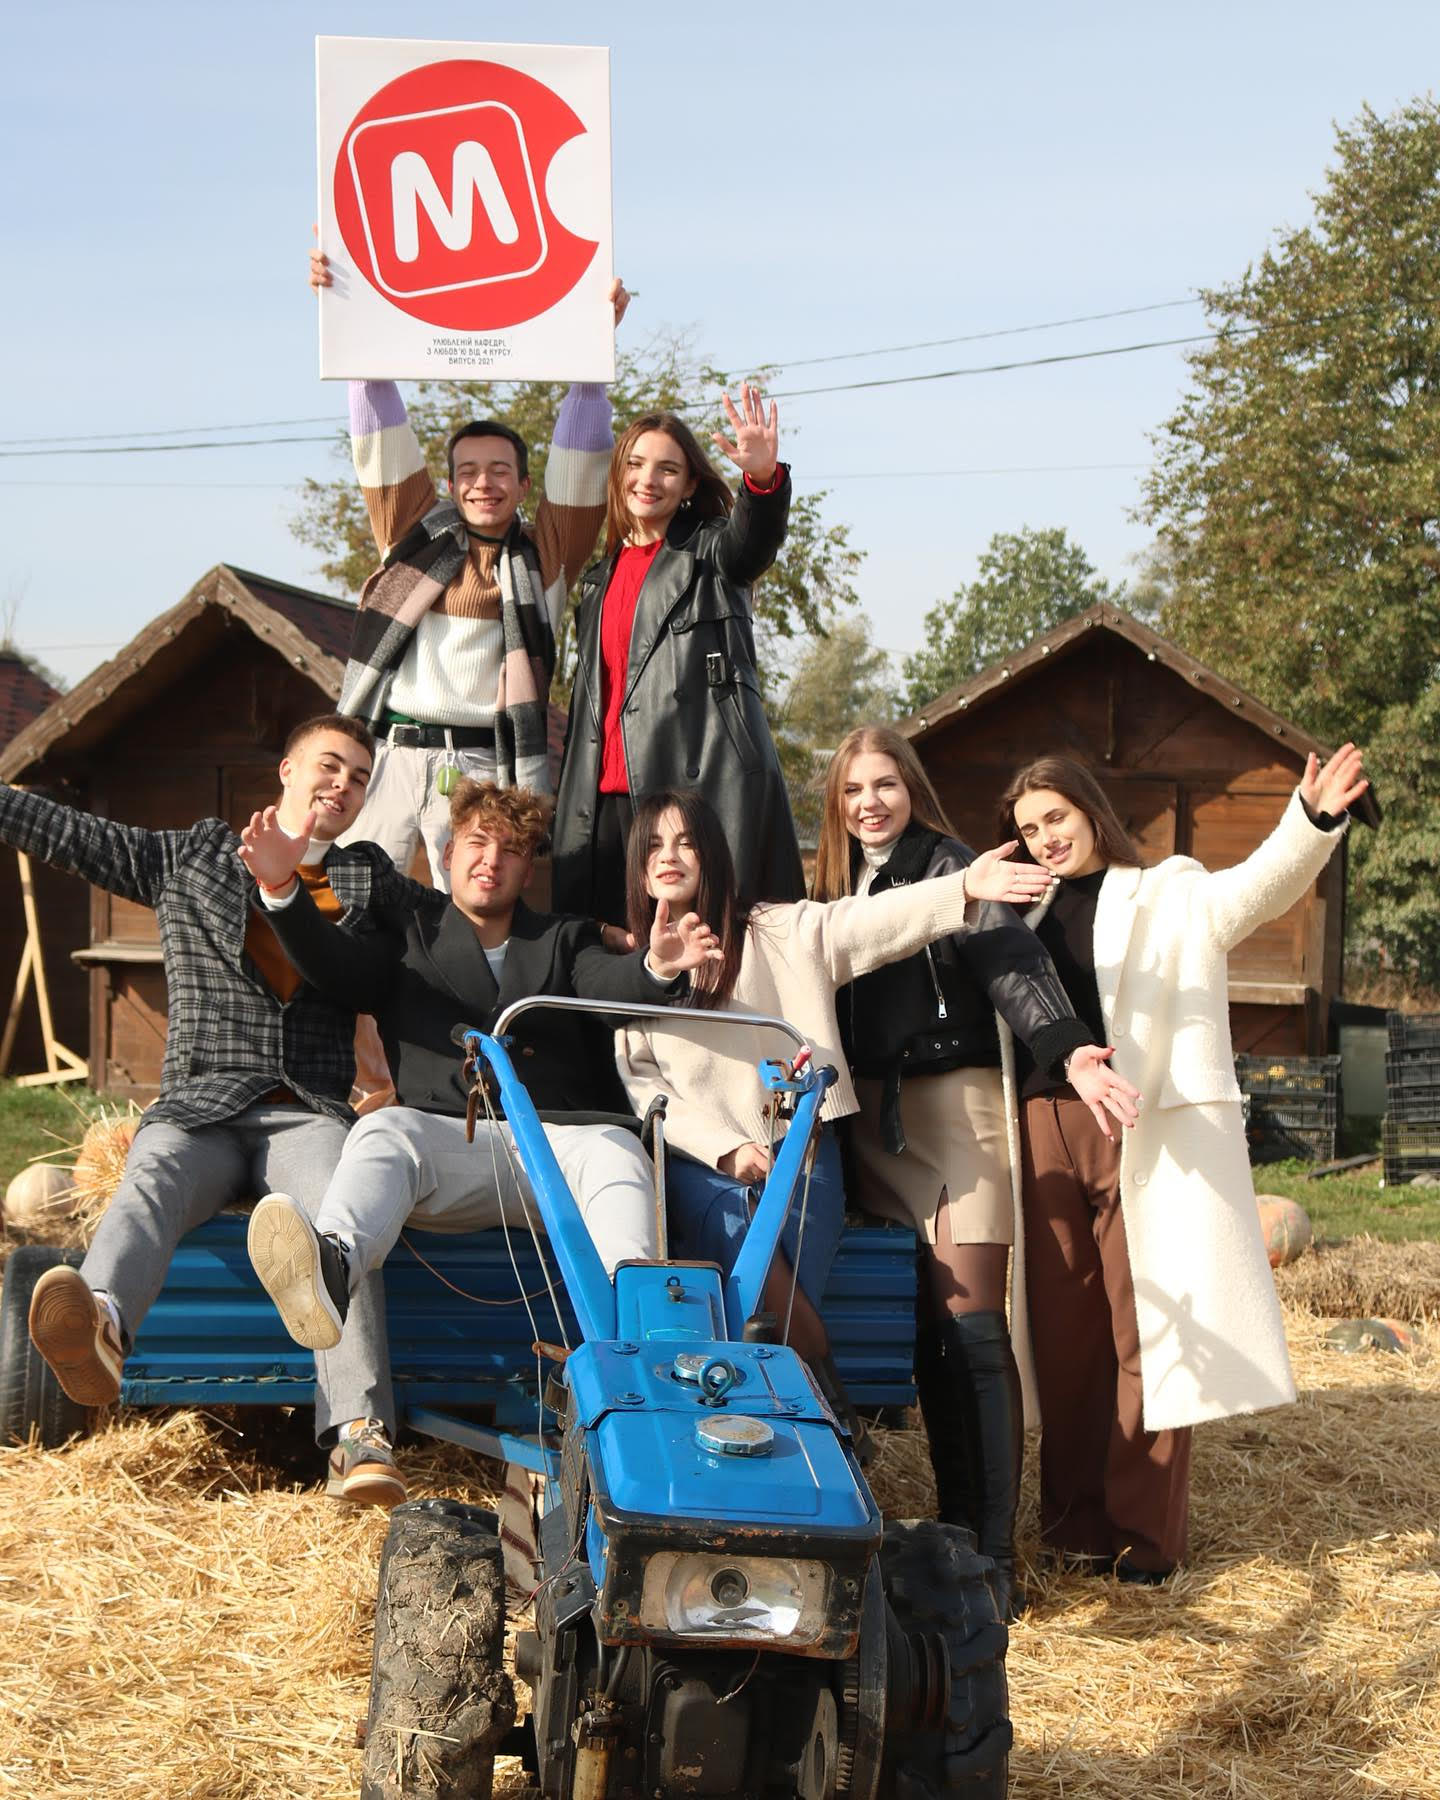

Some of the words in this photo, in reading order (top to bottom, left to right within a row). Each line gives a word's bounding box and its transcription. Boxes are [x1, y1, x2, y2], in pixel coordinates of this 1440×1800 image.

[432, 337, 472, 346] УЛЮБЛЕНІЙ
[468, 347, 481, 356] ВІД
[448, 357, 476, 365] ВИПУСК
[478, 357, 494, 365] 2021
